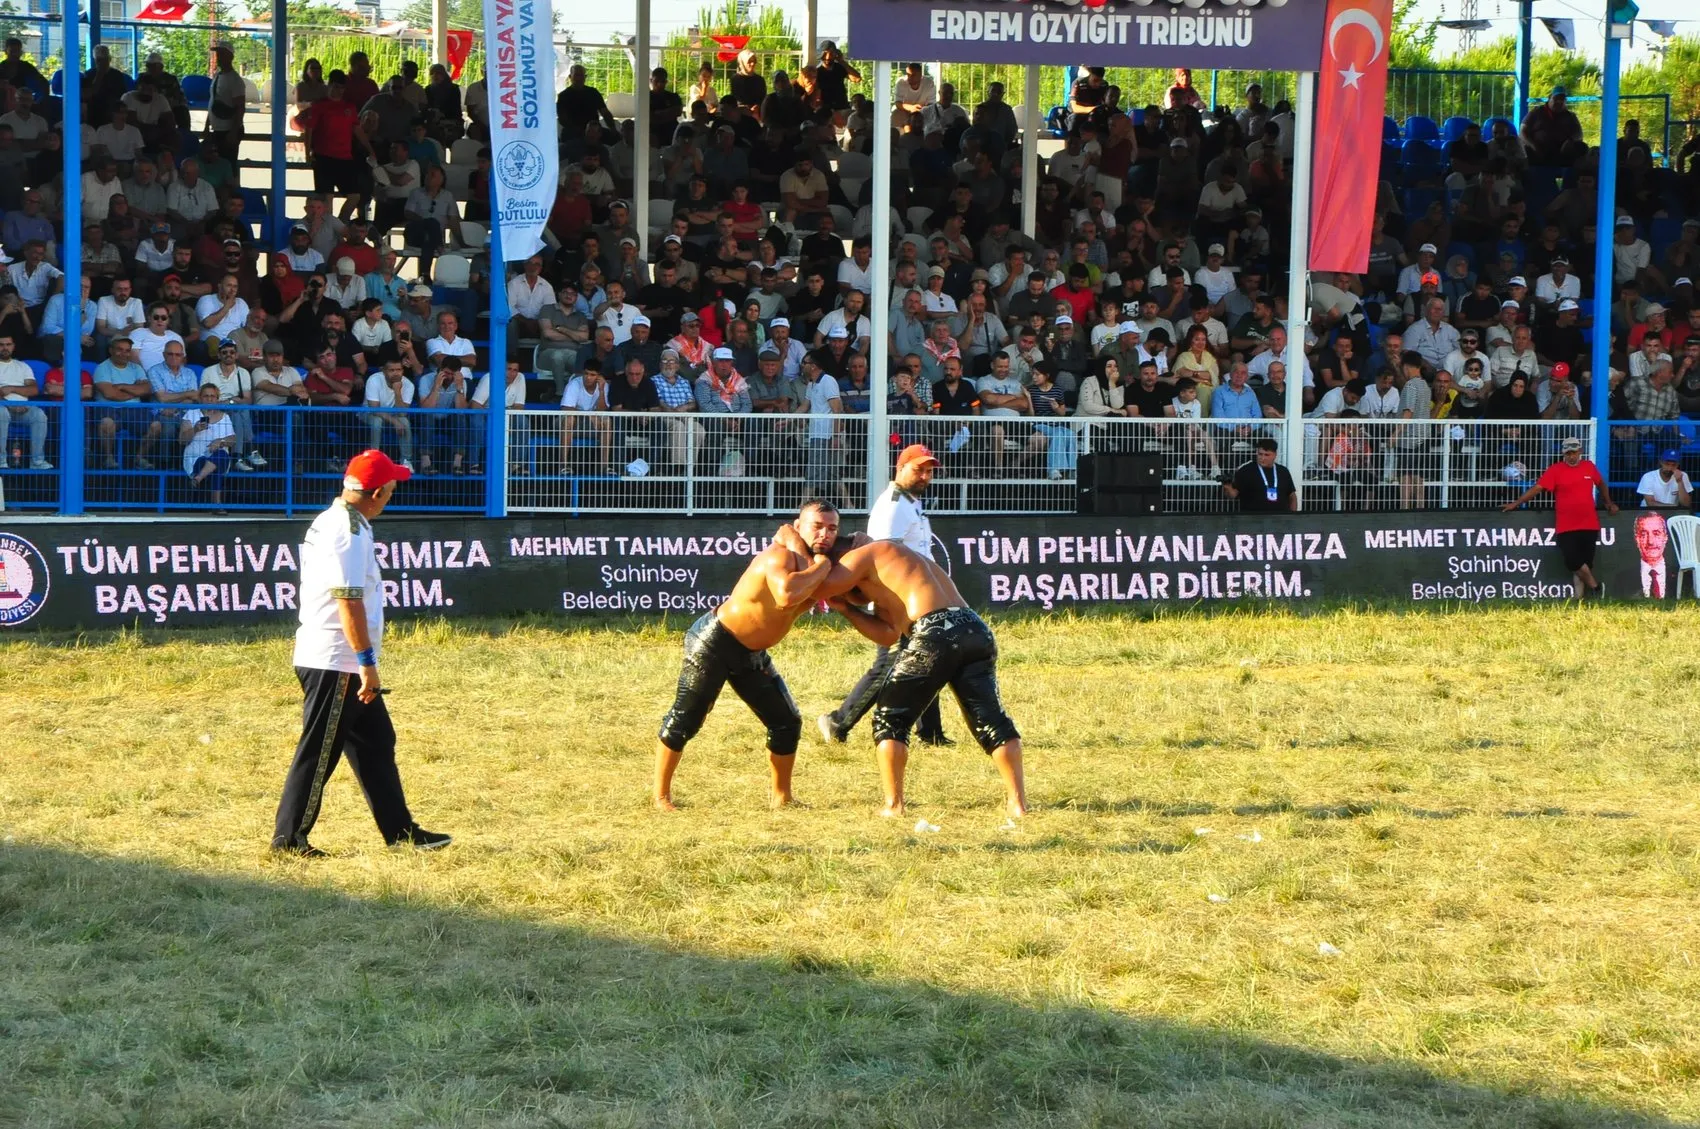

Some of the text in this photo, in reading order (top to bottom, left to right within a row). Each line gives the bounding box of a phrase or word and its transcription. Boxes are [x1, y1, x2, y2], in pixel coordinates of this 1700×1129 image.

[930, 4, 1253, 47] ERDEM ÖZYİĞİT TRİBÜNÜ
[518, 0, 539, 129] SÖZÜMÜZ VA
[506, 197, 538, 210] Besim
[511, 536, 610, 557] MEHMET
[958, 529, 1347, 565] TÜM PEHLİVANLARIMIZA
[1365, 528, 1456, 549] MEHMET
[57, 537, 491, 575] TÜM PEHLİVARIMIZA
[1448, 554, 1541, 578] Şahinbey
[600, 564, 699, 588] Şahinbey
[991, 563, 1311, 609] BAŞARILAR DİLERİM.
[96, 581, 298, 622] BAŞARILAR
[564, 590, 652, 613] Belediye
[1412, 580, 1575, 603] Belediye Başkan
